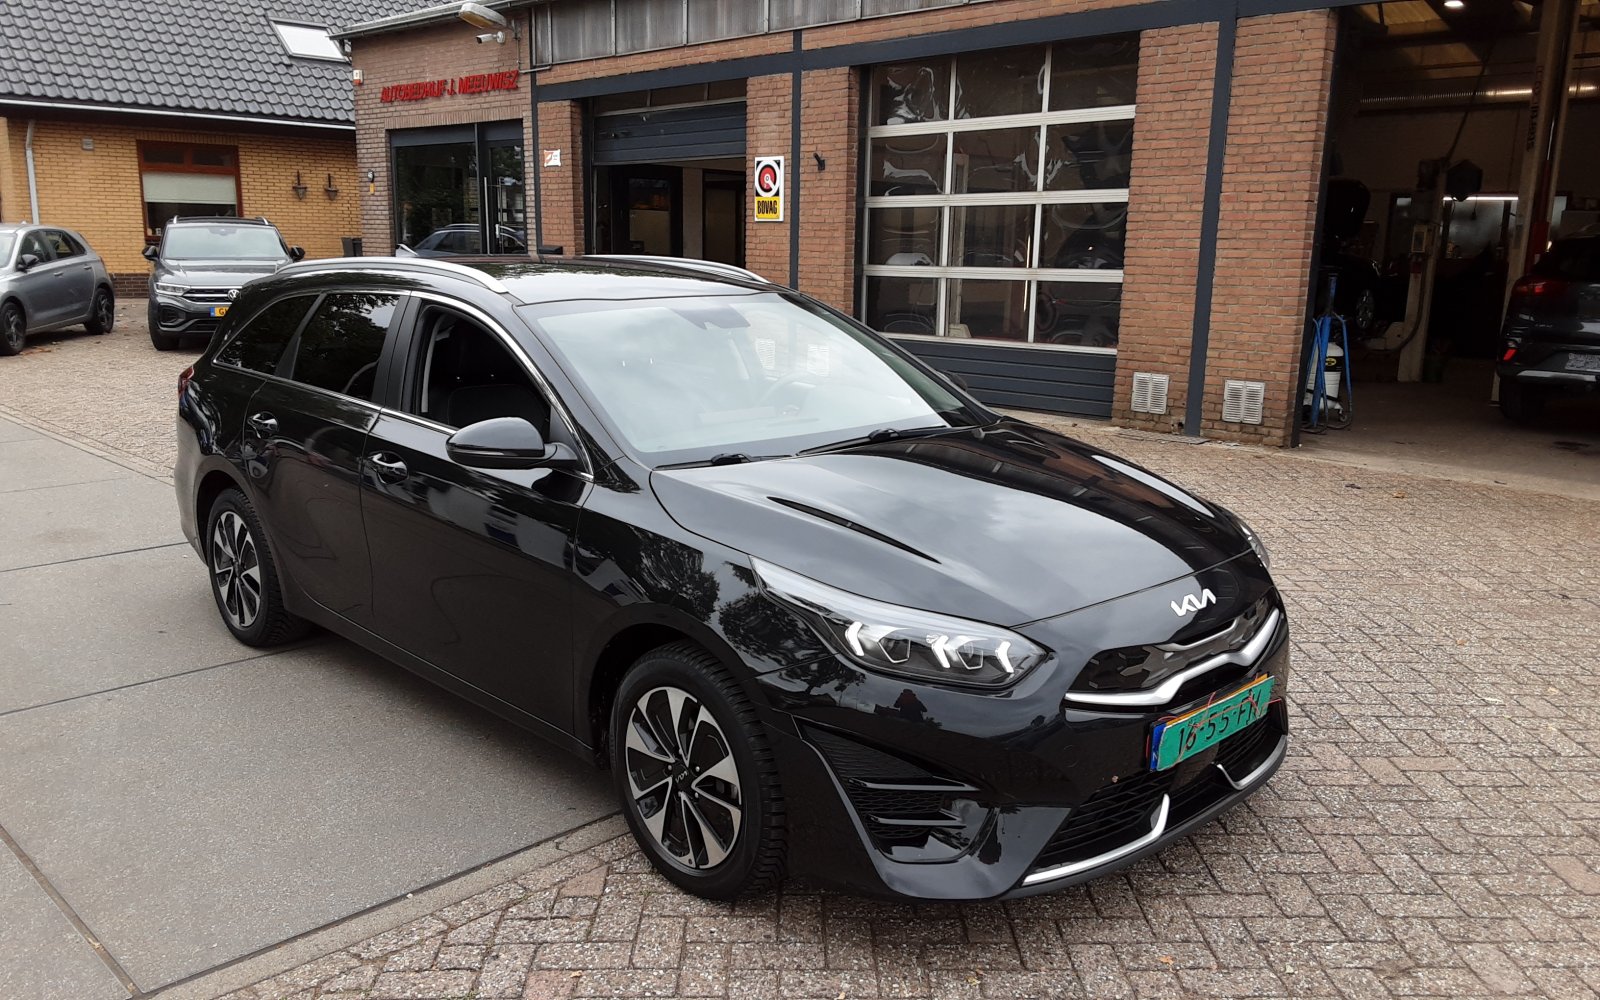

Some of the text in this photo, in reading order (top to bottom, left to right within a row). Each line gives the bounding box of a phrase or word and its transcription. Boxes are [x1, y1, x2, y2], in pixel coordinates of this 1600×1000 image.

[380, 79, 447, 103] AUTOBEDRIJF
[757, 200, 778, 215] BOVAG
[1170, 588, 1217, 617] KIA
